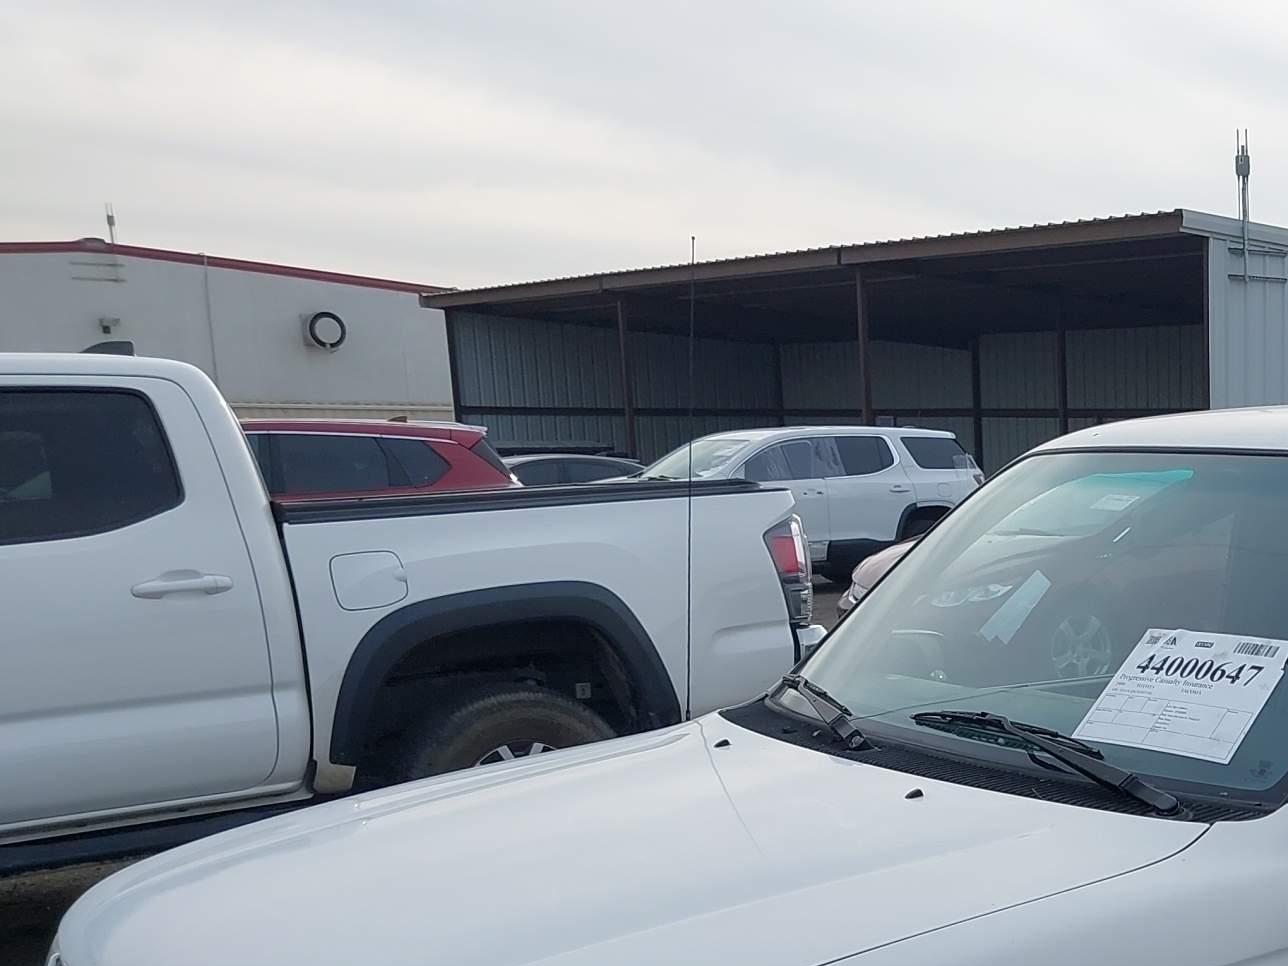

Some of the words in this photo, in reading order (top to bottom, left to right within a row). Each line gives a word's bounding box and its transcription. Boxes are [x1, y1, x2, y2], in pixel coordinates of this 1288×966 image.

[1119, 673, 1154, 684] Progressive
[1155, 677, 1182, 687] Casualty
[1182, 680, 1214, 690] Insurance
[1136, 653, 1264, 687] 44000647
